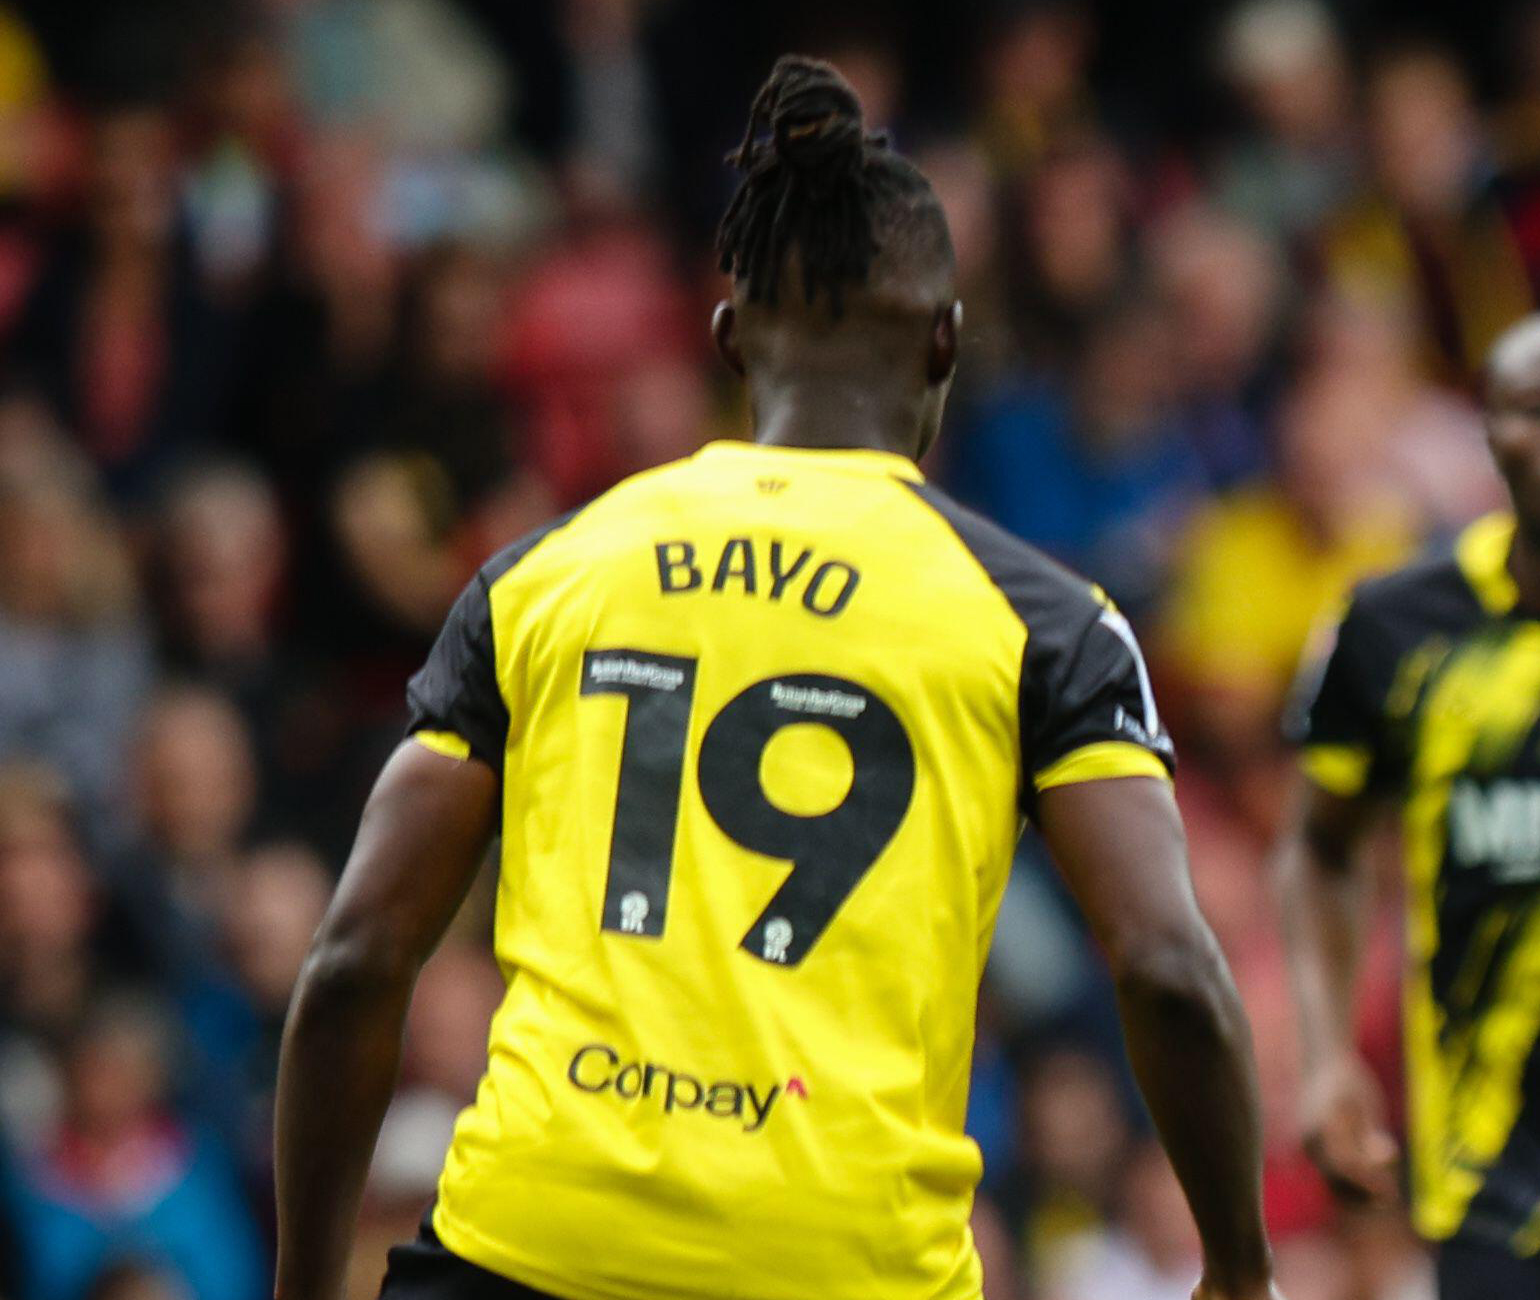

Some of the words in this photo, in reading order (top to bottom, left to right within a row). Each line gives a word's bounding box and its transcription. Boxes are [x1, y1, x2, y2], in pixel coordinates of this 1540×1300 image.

[655, 537, 861, 619] BAYO
[578, 647, 917, 969] 19
[567, 1043, 781, 1133] Corpay
